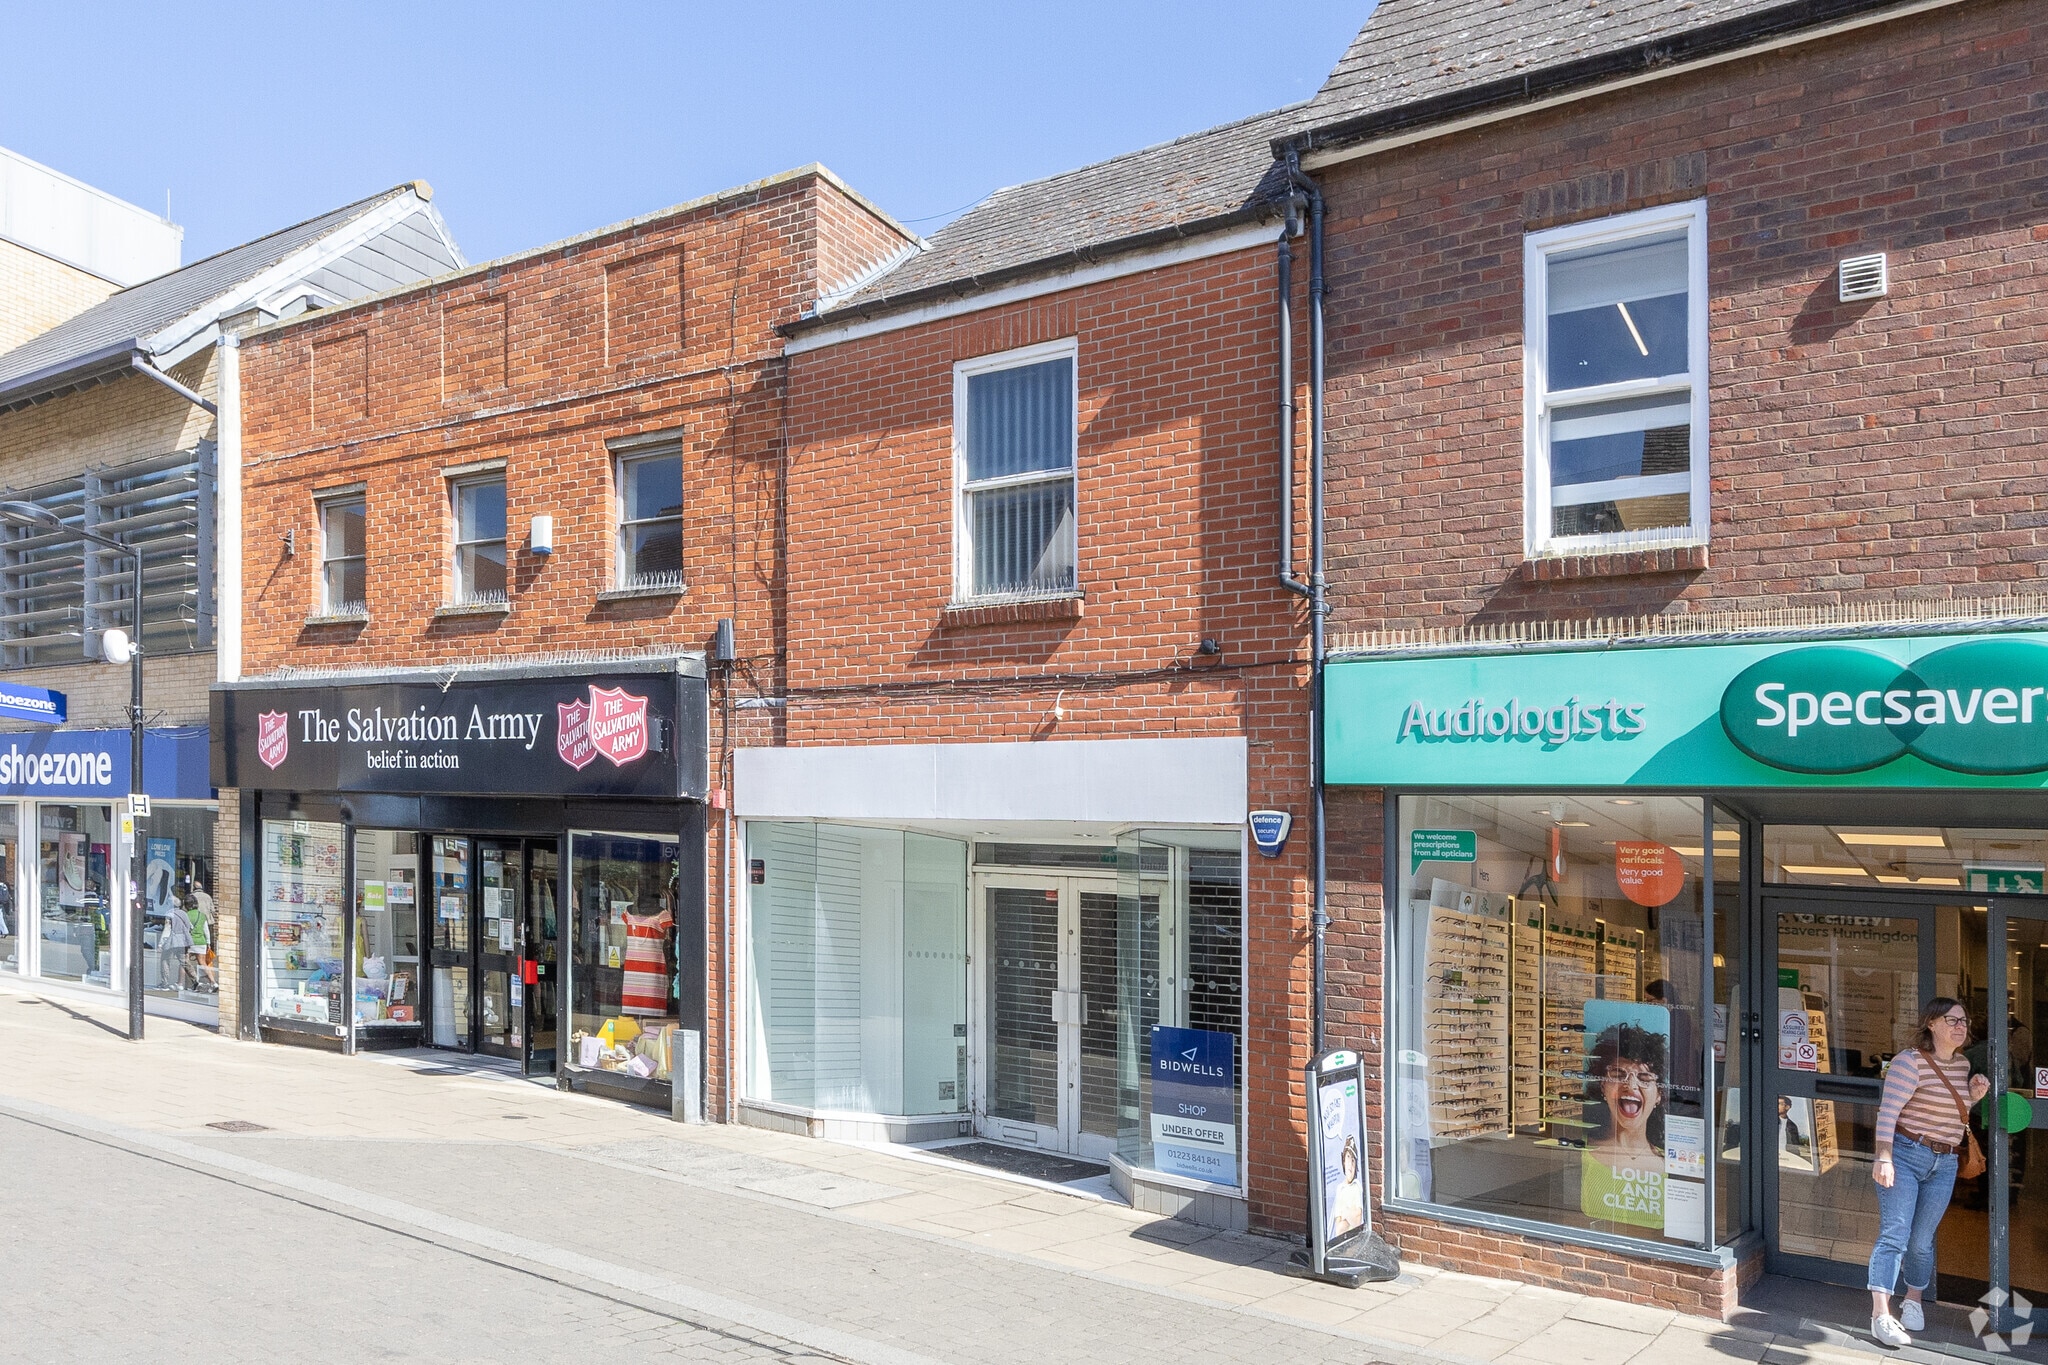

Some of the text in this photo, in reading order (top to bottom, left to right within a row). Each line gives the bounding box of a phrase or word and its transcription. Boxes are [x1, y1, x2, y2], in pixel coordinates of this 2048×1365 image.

[603, 698, 623, 717] THE
[1755, 682, 2048, 737] Specsaver
[264, 717, 276, 734] THE
[298, 703, 543, 750] The Salvation Army
[566, 708, 581, 728] THE
[594, 707, 642, 740] SALVATION
[1401, 695, 1647, 744] Audiologists
[259, 720, 287, 752] SALVATION
[560, 719, 590, 751] SALVATIO
[611, 728, 640, 754] ARMY
[268, 737, 285, 761] ARMY
[0, 744, 112, 785] shoezone
[367, 750, 460, 769] belief in action
[1253, 816, 1282, 824] defence
[1413, 841, 1460, 850] prescriptions
[1619, 846, 1665, 856] Very good
[1620, 857, 1665, 865] varifocals.
[1619, 868, 1664, 877] Very good
[1620, 877, 1644, 885] value.
[1833, 927, 1919, 943] Huntingdon
[1160, 1059, 1224, 1077] BIDWELLS
[1178, 1103, 1207, 1116] SHOP
[1162, 1123, 1224, 1140] UNDER OFFER
[1167, 1149, 1221, 1167] 01223 841 841
[1176, 1162, 1213, 1174] bidwells.co.uk
[1612, 1165, 1662, 1186] LOUD
[1621, 1182, 1662, 1200] AND
[1603, 1193, 1661, 1216] CLEAR
